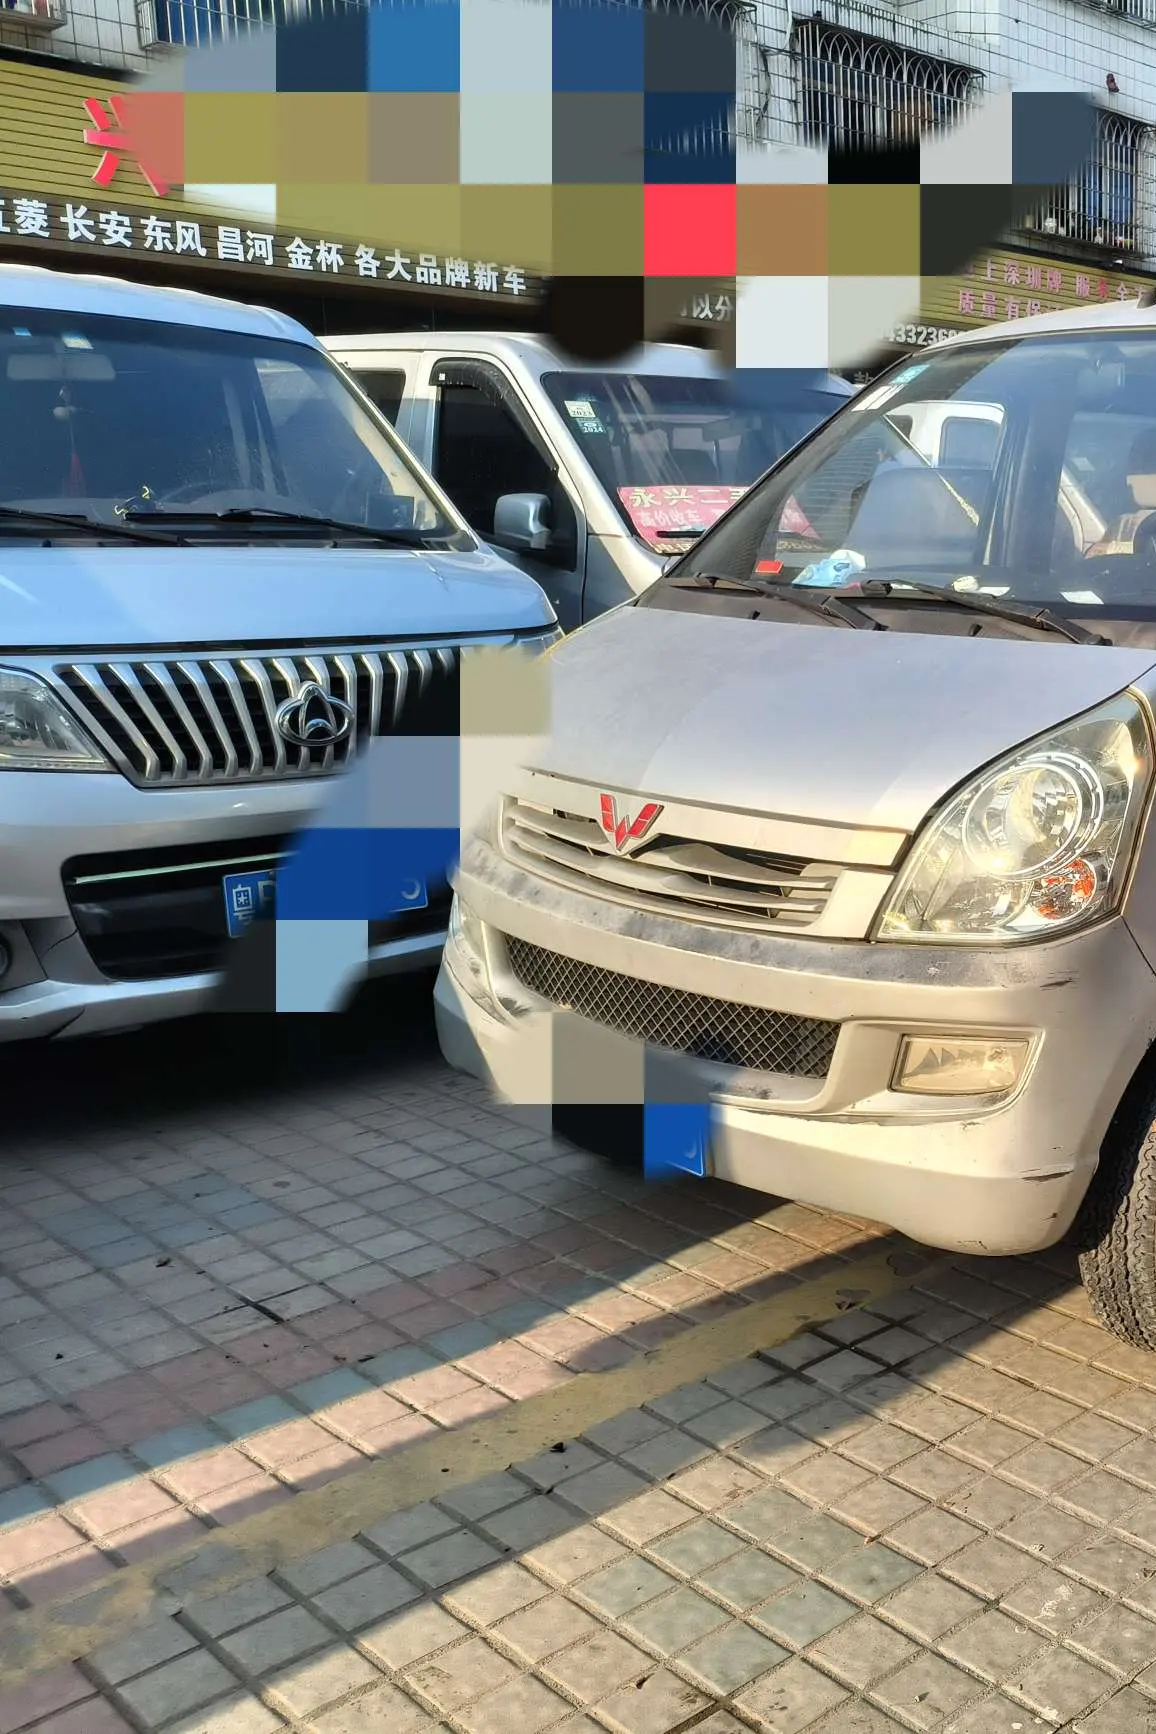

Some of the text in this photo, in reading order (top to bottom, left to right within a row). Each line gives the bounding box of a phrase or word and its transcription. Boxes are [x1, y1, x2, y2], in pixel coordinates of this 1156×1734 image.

[60, 203, 133, 248] 长安
[140, 215, 207, 257] 东风
[217, 225, 274, 266] 昌河
[285, 236, 345, 273] 金杯
[354, 243, 527, 296] 各大品牌新车
[680, 294, 734, 321] 以分
[959, 289, 1062, 319] 质量有保
